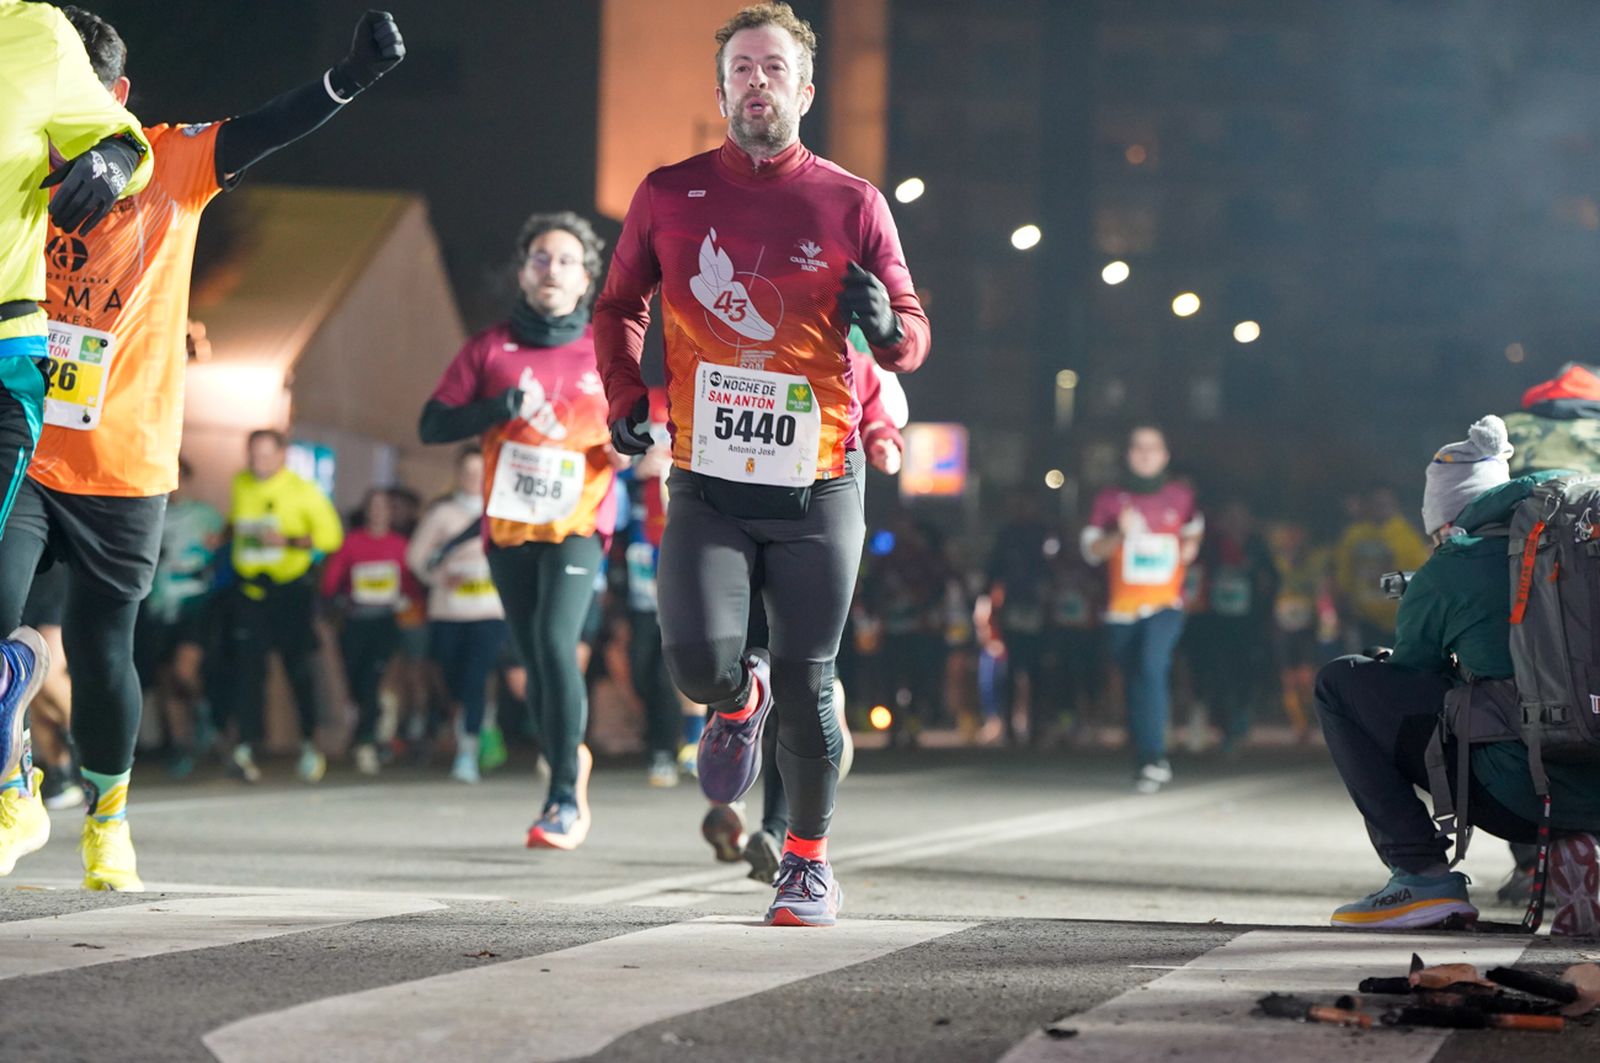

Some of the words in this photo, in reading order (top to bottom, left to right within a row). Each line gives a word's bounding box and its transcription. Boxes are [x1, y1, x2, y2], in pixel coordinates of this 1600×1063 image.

[46, 272, 109, 284] OBILIARIA
[713, 290, 748, 323] 43
[59, 334, 73, 346] DE
[722, 379, 760, 395] NOCHE
[761, 384, 777, 397] DE
[708, 390, 732, 405] SAN
[714, 406, 796, 447] 5440
[728, 443, 757, 455] Antonio
[758, 446, 776, 456] José
[1372, 887, 1412, 908] HOKA
